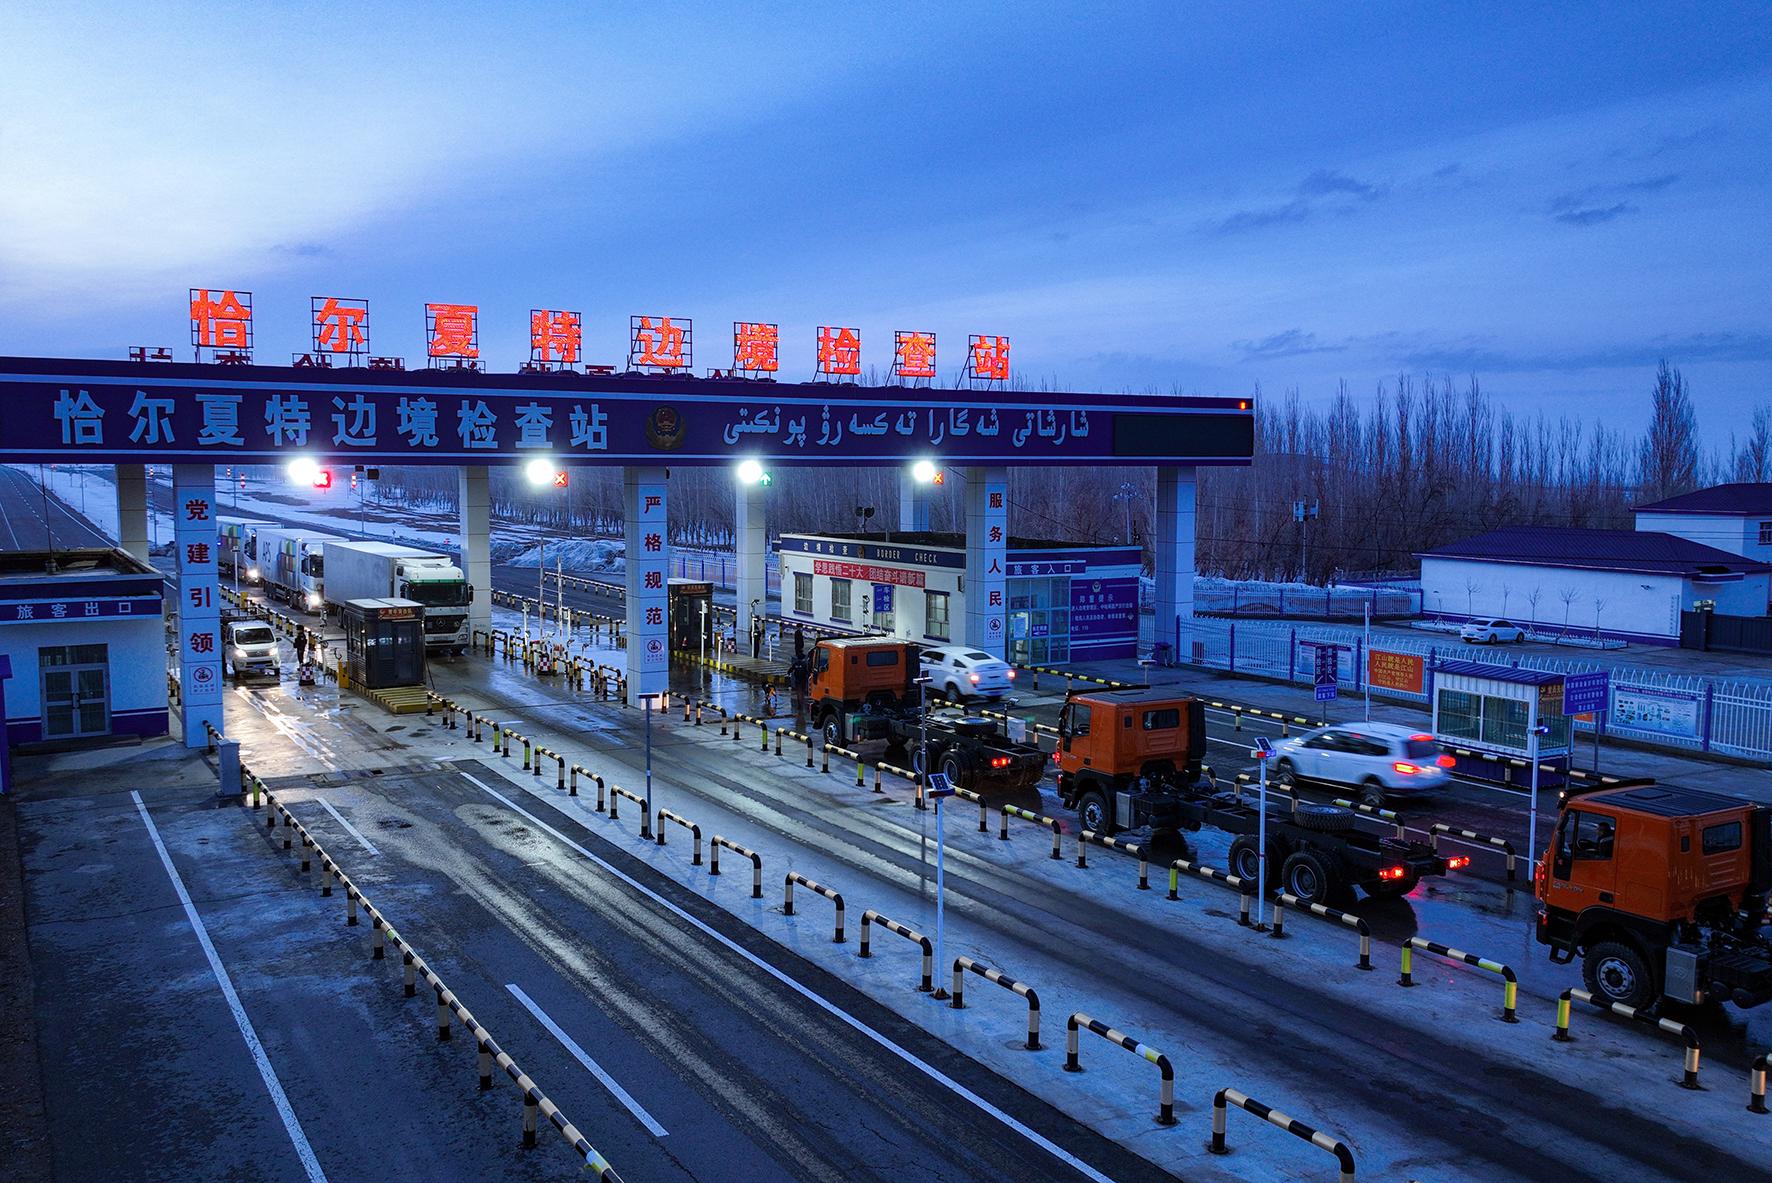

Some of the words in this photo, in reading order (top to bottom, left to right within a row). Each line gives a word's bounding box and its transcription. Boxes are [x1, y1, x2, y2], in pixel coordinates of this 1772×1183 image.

[190, 289, 1010, 380] 恰尔夏特边境检查站
[54, 388, 608, 451] 恰尔夏特边境检查站
[185, 498, 214, 654] 党建引领
[644, 495, 663, 626] 严格规范
[876, 548, 901, 560] BORDER
[914, 552, 938, 564] CHECK
[988, 492, 1003, 608] 服务人民
[1013, 564, 1072, 575] 旅客入口
[17, 602, 133, 620] 旅客出口
